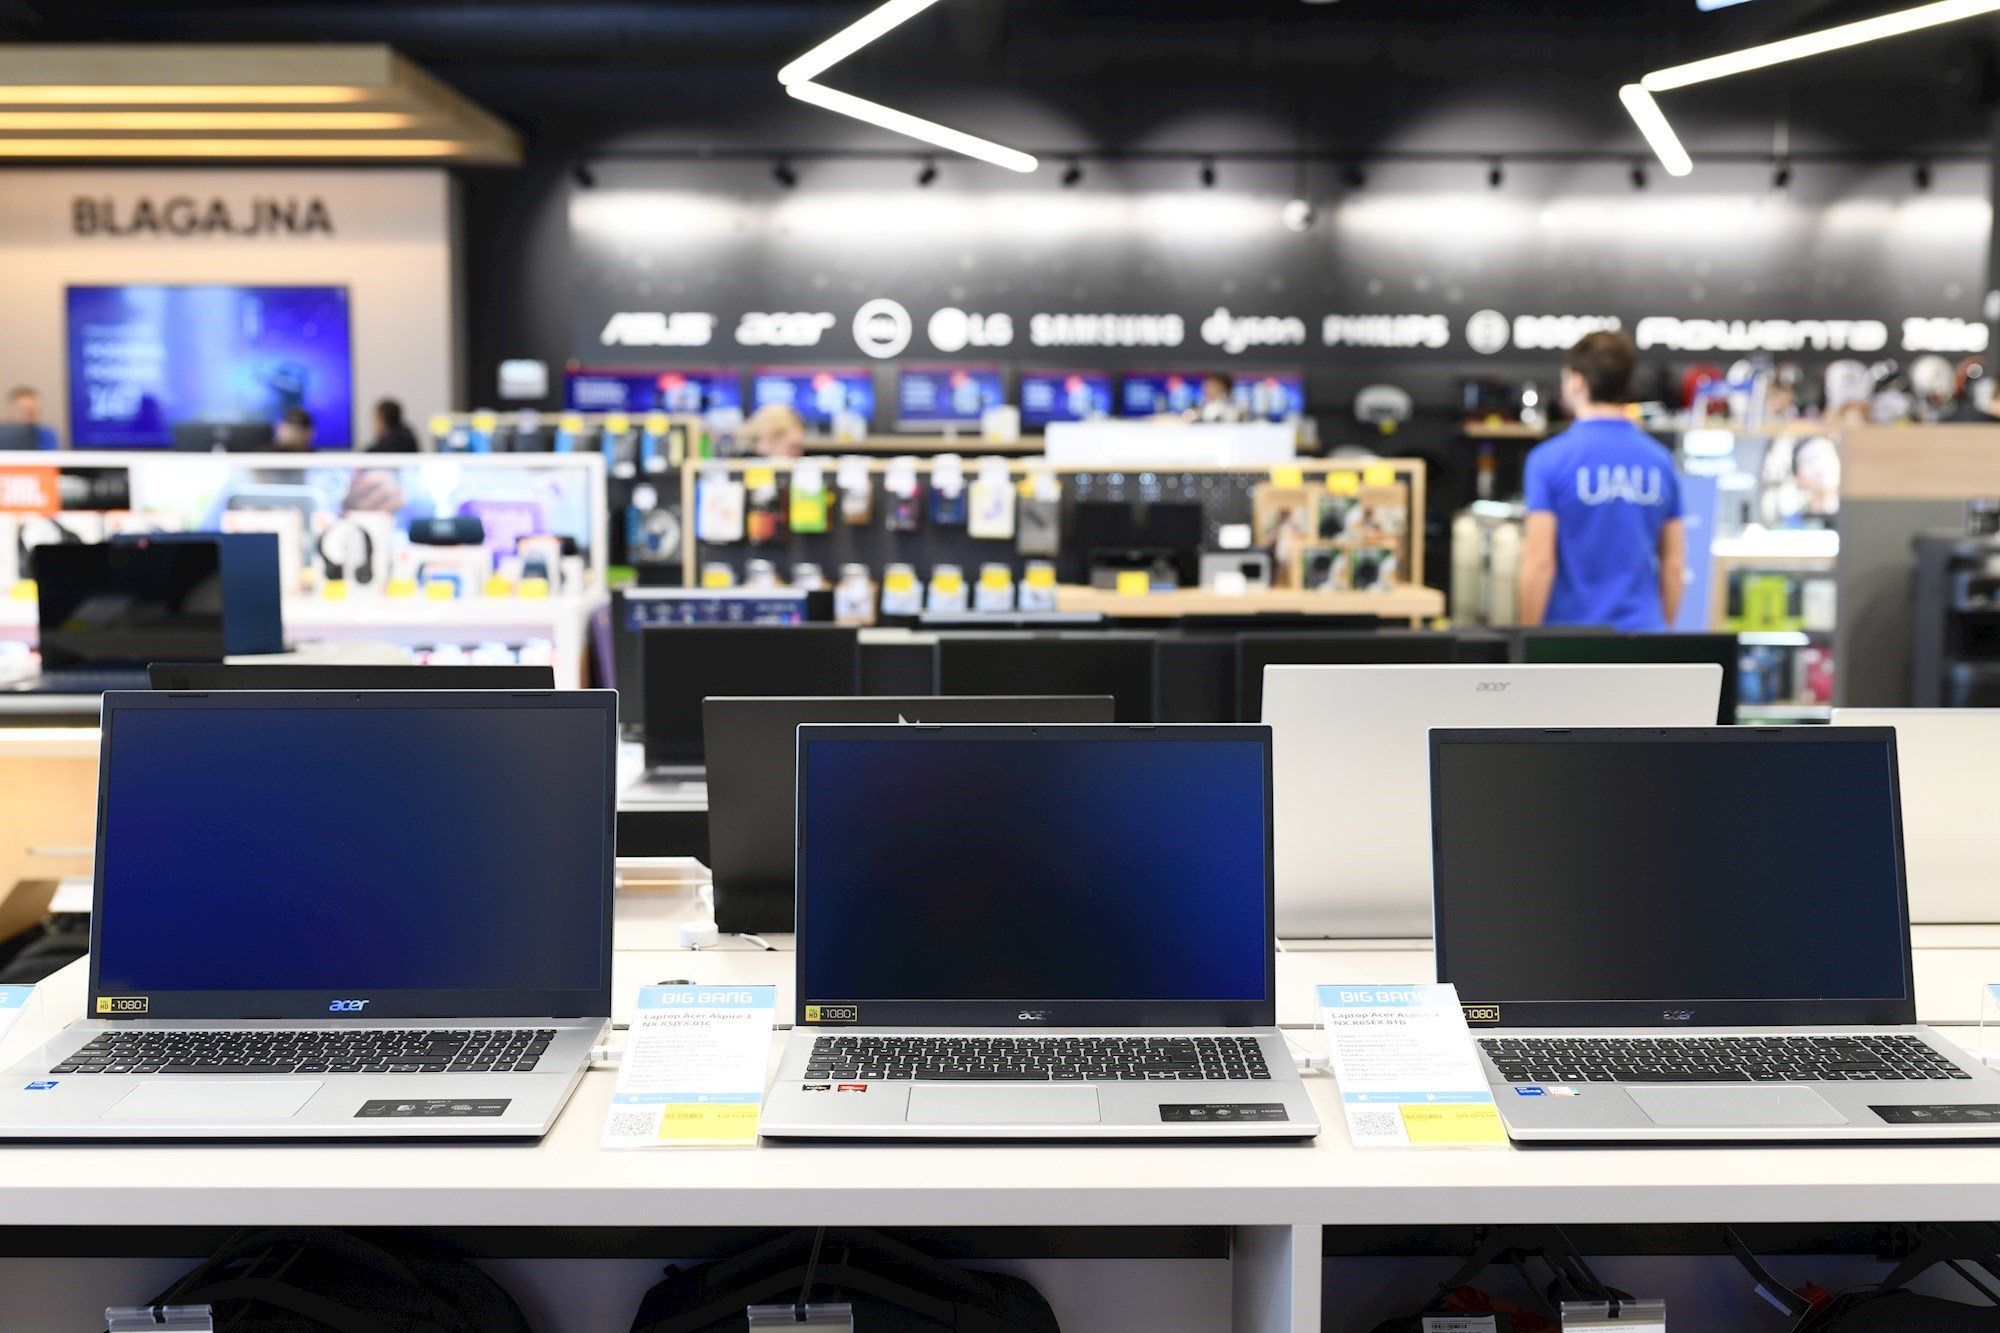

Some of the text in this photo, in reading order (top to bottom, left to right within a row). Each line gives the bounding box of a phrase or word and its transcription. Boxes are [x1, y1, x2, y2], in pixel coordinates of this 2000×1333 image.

[72, 196, 335, 237] BLAGAJNA
[966, 312, 1012, 347] LG
[1030, 313, 1185, 347] SAMSUNG
[1201, 306, 1306, 354] dyson
[1322, 314, 1449, 348] PHILIPS
[1577, 464, 1662, 505] UAU
[1475, 682, 1511, 692] acer
[662, 991, 752, 1004] BIG BANG
[1340, 991, 1432, 1003] BIG BANG
[117, 1000, 142, 1010] 1080
[328, 999, 370, 1012] acer
[644, 1013, 681, 1021] Laptop
[709, 1013, 743, 1021] Aspire
[826, 1008, 851, 1019] 1080
[1331, 1012, 1369, 1020] Laptop
[1467, 1009, 1494, 1019] 1080
